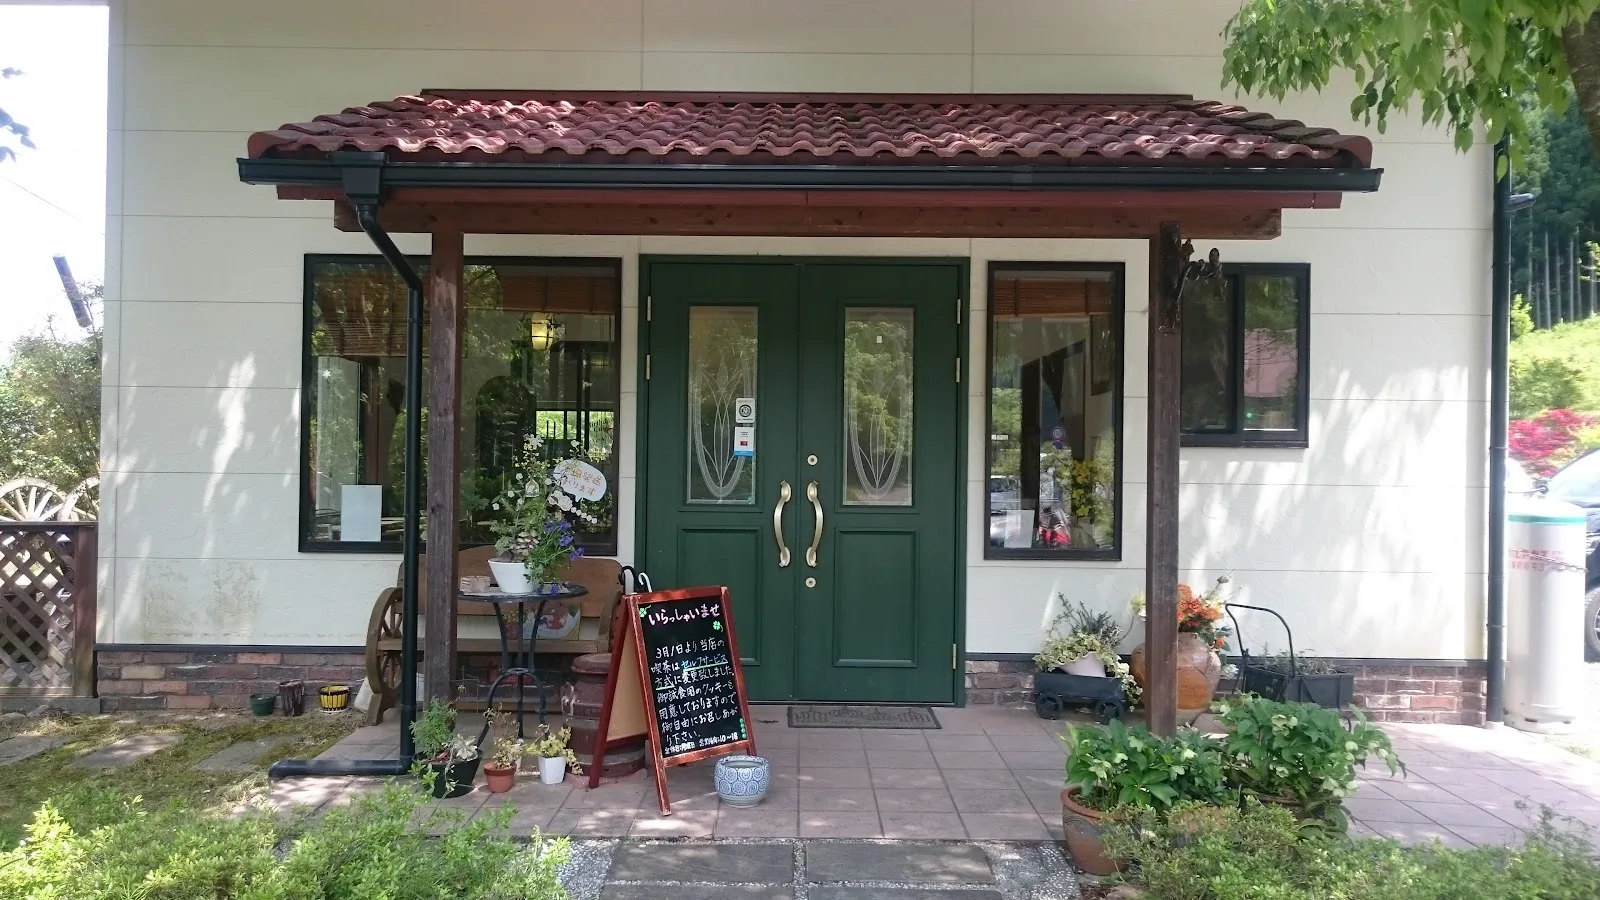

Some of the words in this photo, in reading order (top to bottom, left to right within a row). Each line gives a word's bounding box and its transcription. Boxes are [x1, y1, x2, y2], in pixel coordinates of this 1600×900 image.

[648, 603, 720, 626] いらっしゃいませ
[659, 691, 737, 720] 用意しておりますので
[661, 707, 738, 733] 御自由にお召しあが
